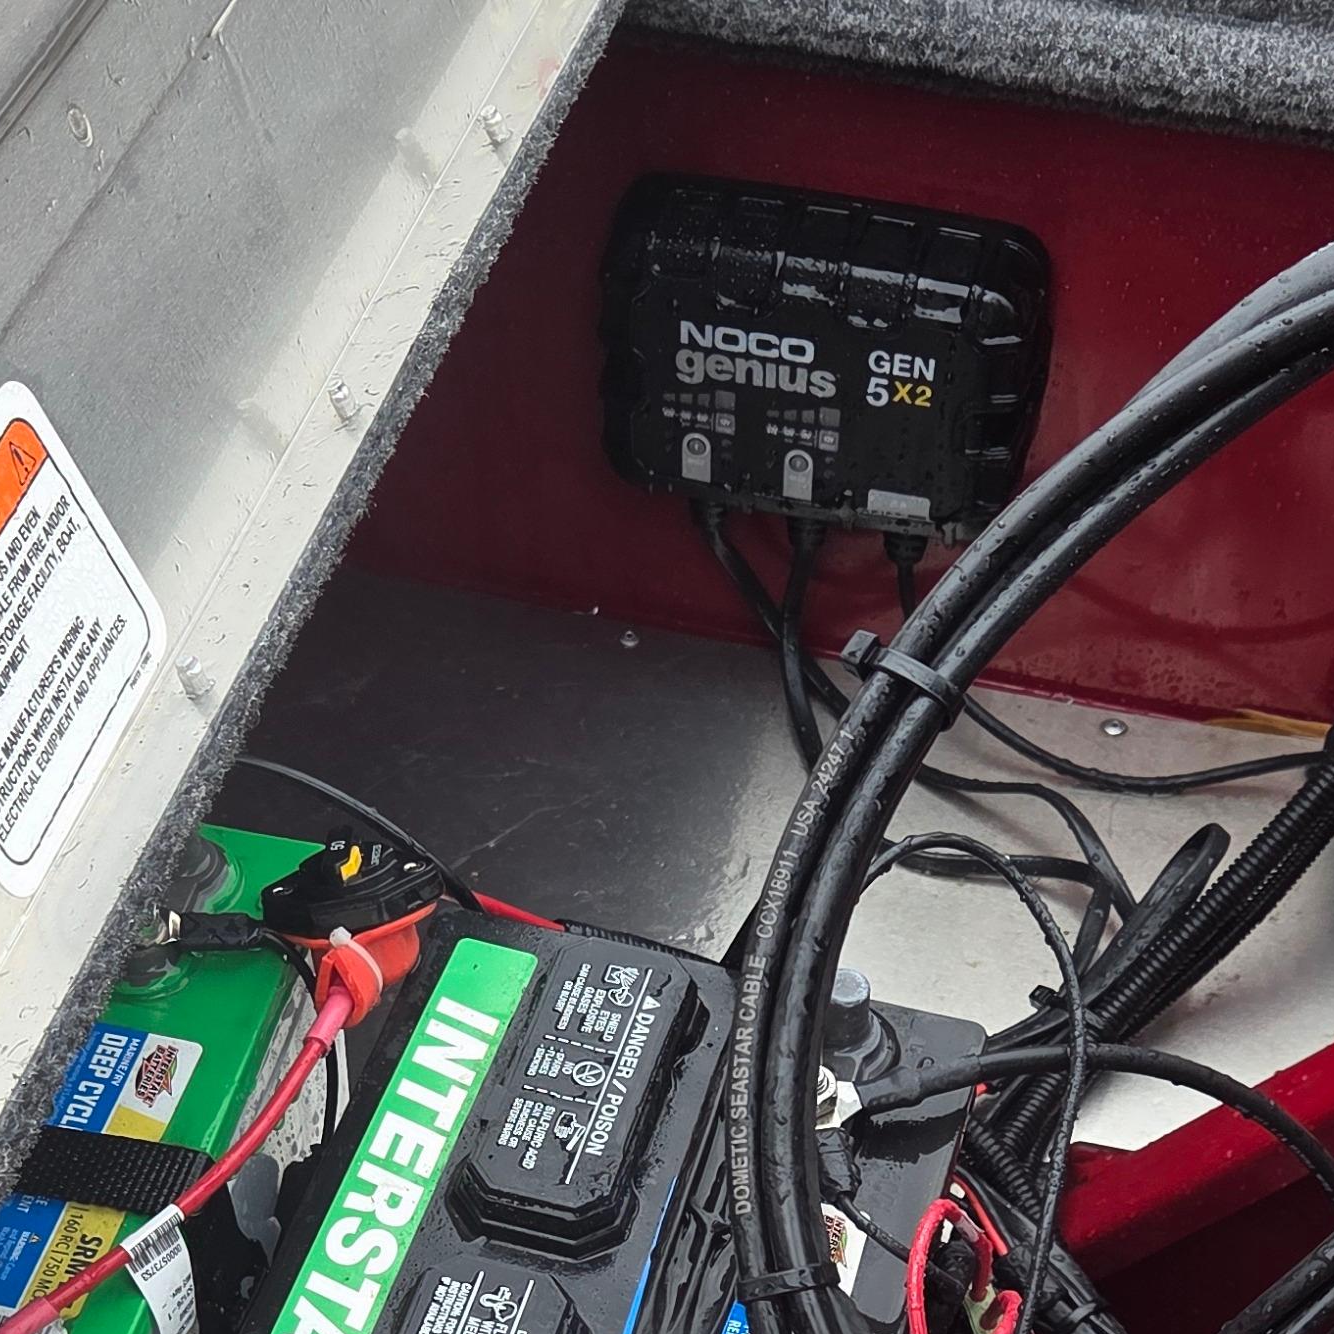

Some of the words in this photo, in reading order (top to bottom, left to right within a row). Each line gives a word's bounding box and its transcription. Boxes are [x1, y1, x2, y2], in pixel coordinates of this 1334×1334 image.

[680, 320, 815, 364] NOCO
[676, 348, 838, 399] genius
[868, 350, 937, 381] GEN
[5, 536, 22, 565] AND
[18, 506, 41, 542] EVEN
[7, 559, 31, 597] FROM
[27, 535, 46, 566] FIRE
[27, 550, 62, 603] FACILITY,
[57, 616, 84, 660] WIRING
[31, 704, 56, 742] WHEN
[51, 642, 91, 709] INSTALLING
[87, 618, 102, 647] ANY
[36, 702, 75, 772] EQUIPMENT
[73, 680, 89, 709] AND
[86, 614, 127, 685] APPLIANCES.
[563, 980, 573, 991] OR
[579, 964, 591, 977] CAN
[571, 977, 585, 998] CAUSE
[577, 987, 595, 1014] GASES
[557, 997, 577, 1029] BLINDNESS
[581, 989, 606, 1033] EXPLOSIVE
[594, 1010, 610, 1031] EYES
[603, 1013, 621, 1042] SHIELD
[615, 1012, 655, 1078] DANGER
[562, 1061, 575, 1075] NO
[58, 1081, 105, 1131] CYCL
[507, 1098, 524, 1123] SEVERE
[513, 1100, 534, 1135] BLINDNESS
[531, 1102, 544, 1117] CAN
[498, 1123, 514, 1145] BURNS
[522, 1118, 537, 1141] CAUSE
[531, 1106, 555, 1148] SULFURIC
[585, 1093, 623, 1156] POISON
[508, 1137, 518, 1148] OR
[522, 1147, 538, 1169] ACID
[434, 1285, 448, 1302] NOT
[441, 1277, 451, 1285] IF
[431, 1281, 460, 1334] INSTRUCTIONS
[443, 1318, 458, 1334] FOR
